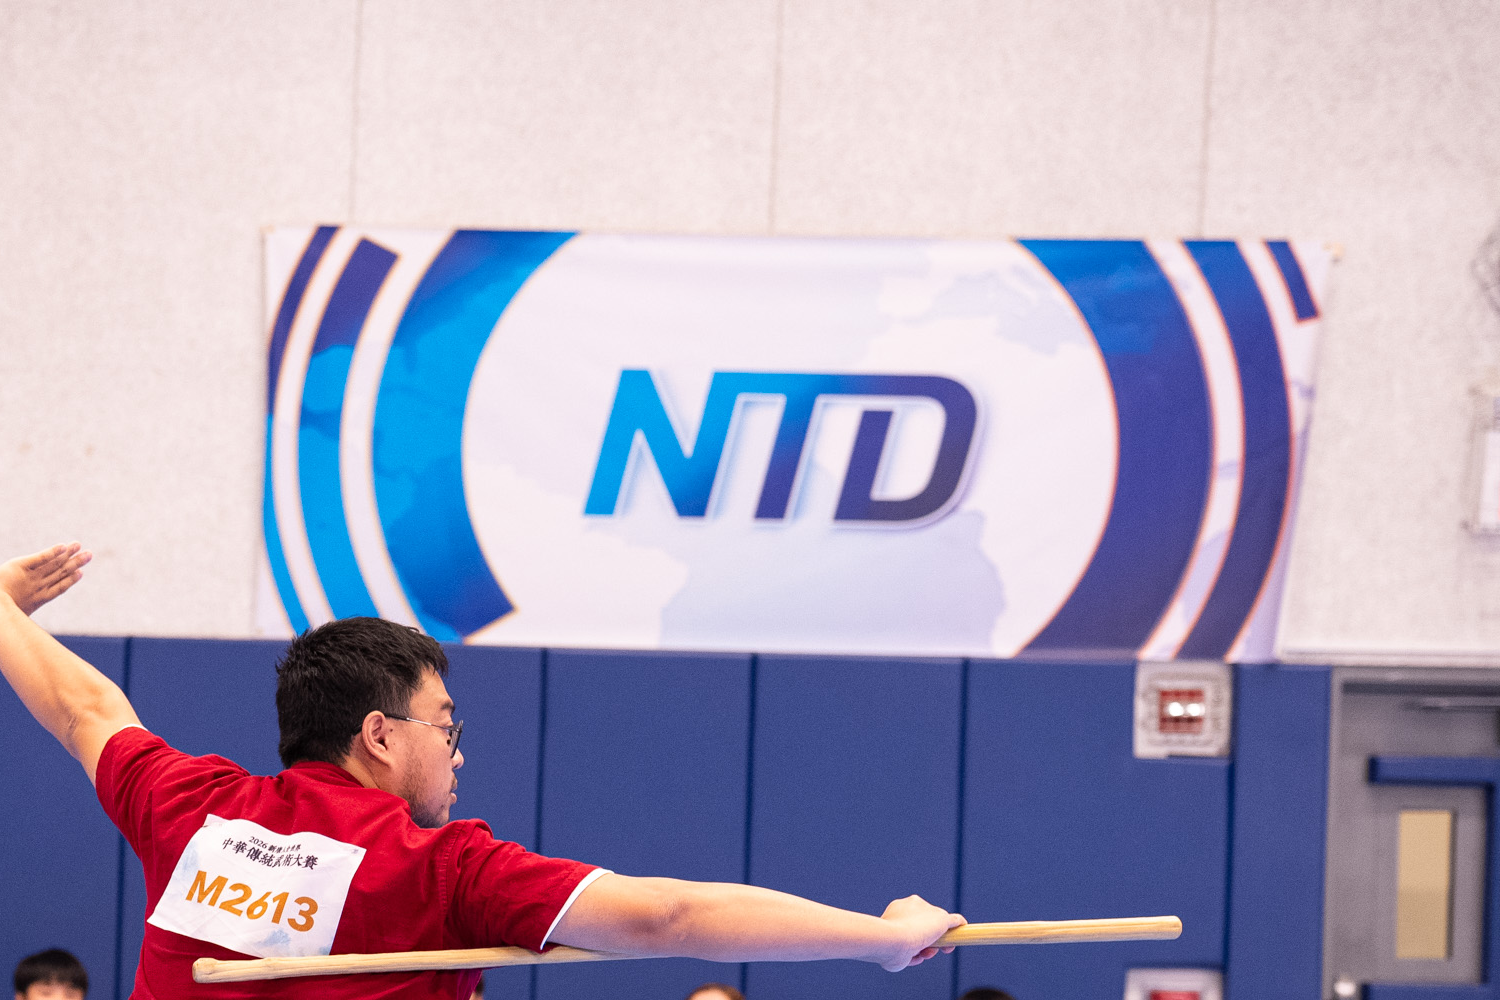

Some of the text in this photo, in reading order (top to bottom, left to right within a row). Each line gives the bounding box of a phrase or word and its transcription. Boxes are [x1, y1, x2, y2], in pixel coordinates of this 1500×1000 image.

[584, 369, 979, 523] NTD
[248, 836, 268, 849] 2026
[185, 870, 319, 932] M2613
